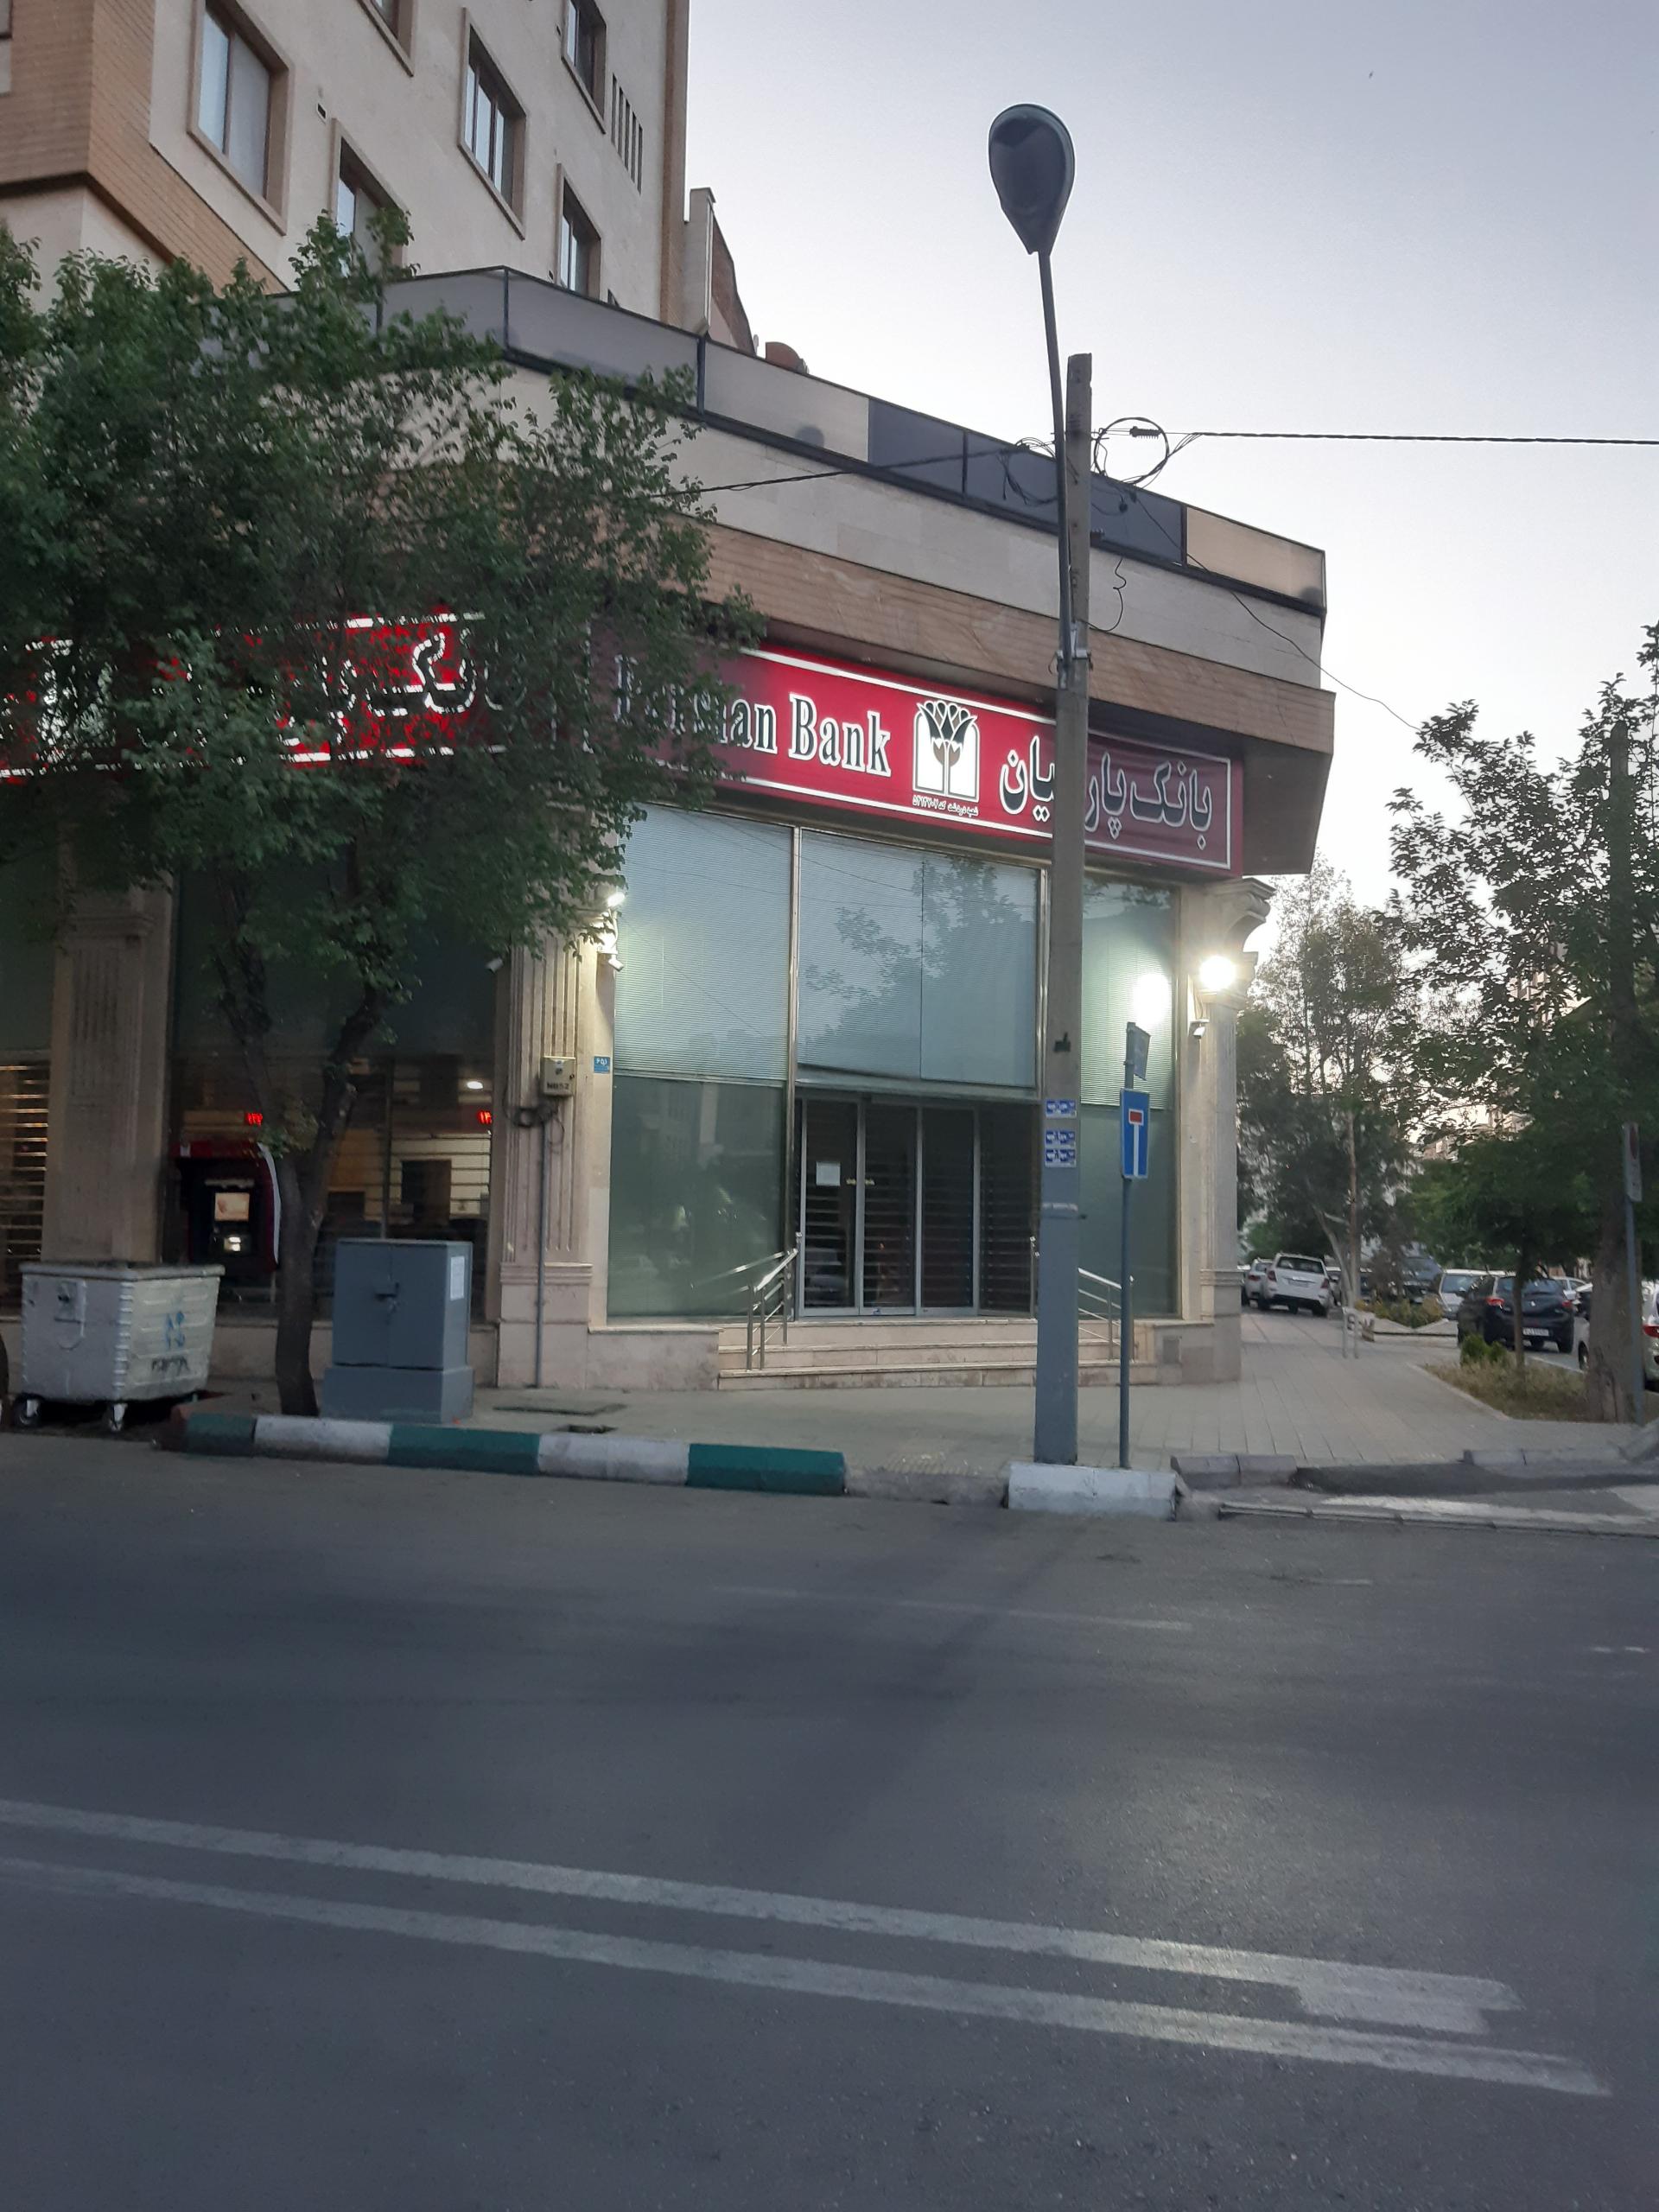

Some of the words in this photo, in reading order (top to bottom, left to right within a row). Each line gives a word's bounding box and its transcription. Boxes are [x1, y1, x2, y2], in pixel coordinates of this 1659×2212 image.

[788, 691, 892, 777] Bank
[999, 734, 1127, 840] پاریان
[1129, 759, 1212, 851] بانک
